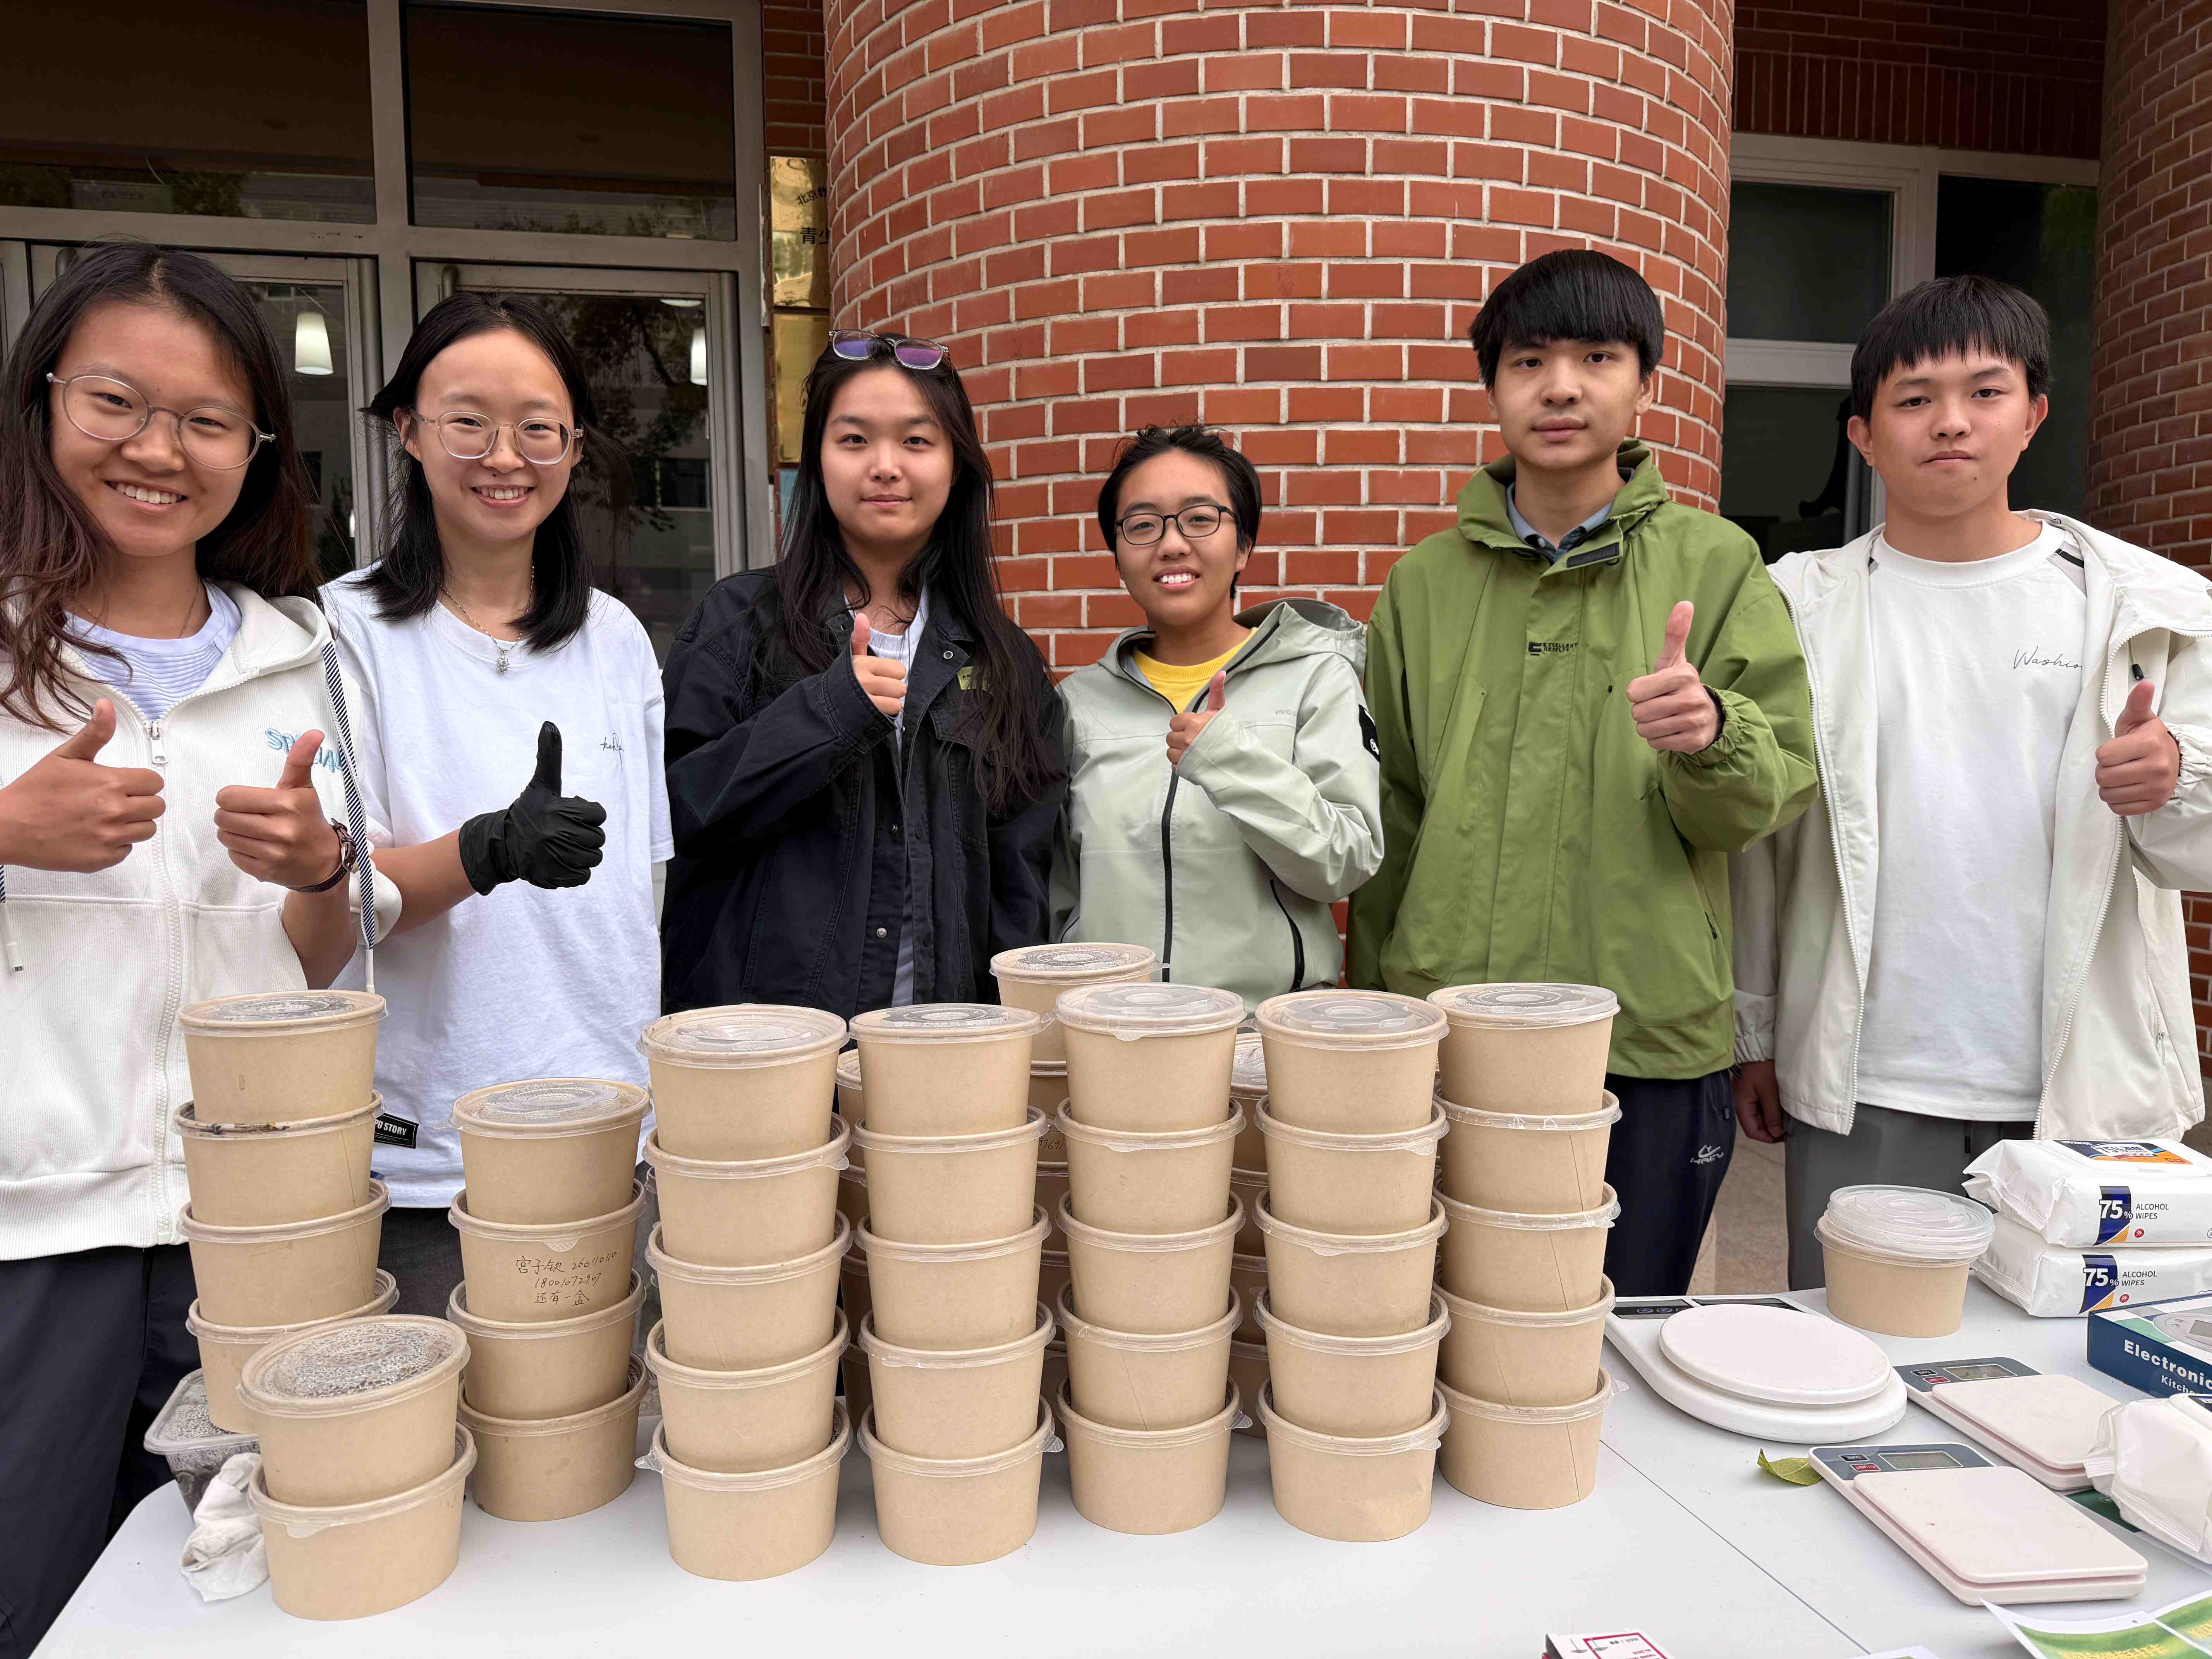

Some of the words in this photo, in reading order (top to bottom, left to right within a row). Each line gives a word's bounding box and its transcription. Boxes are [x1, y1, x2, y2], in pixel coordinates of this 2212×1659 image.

[383, 1122, 407, 1135] STORY
[2099, 1200, 2133, 1220] 75%
[2083, 1267, 2119, 1287] 75%
[2124, 1339, 2212, 1390] Electronic
